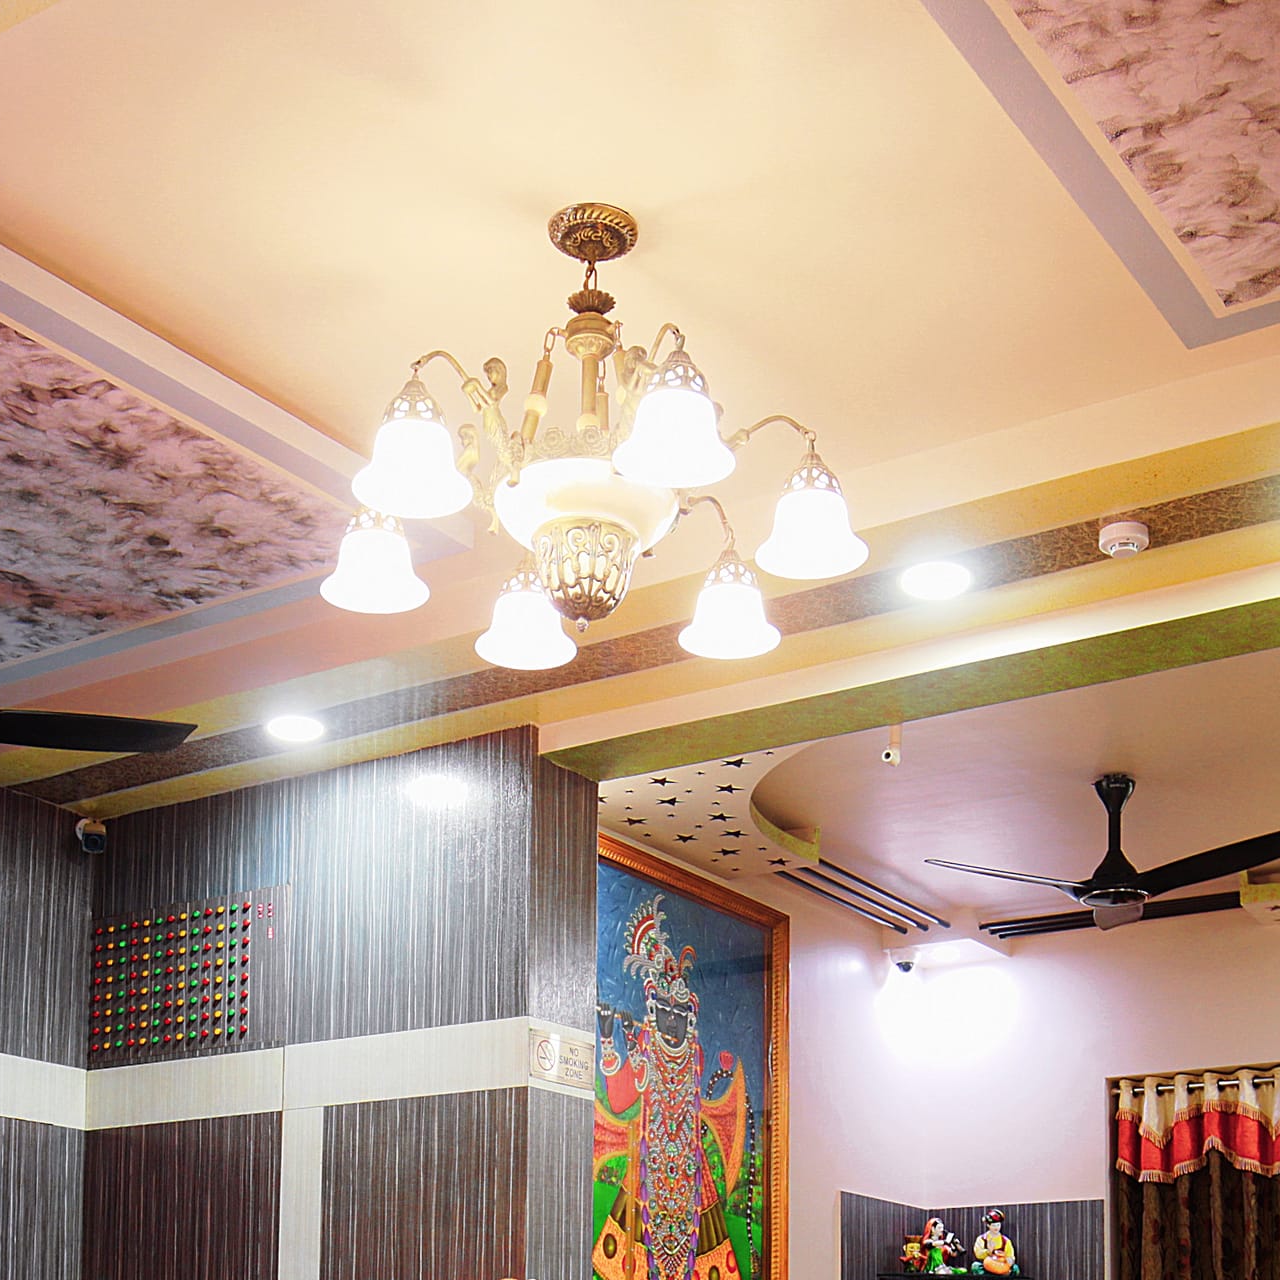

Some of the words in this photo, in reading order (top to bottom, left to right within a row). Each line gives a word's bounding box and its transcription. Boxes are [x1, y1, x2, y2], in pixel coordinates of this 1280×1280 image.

[569, 1047, 579, 1057] NO
[559, 1055, 589, 1070] SMOKING
[565, 1067, 583, 1079] ZONE
